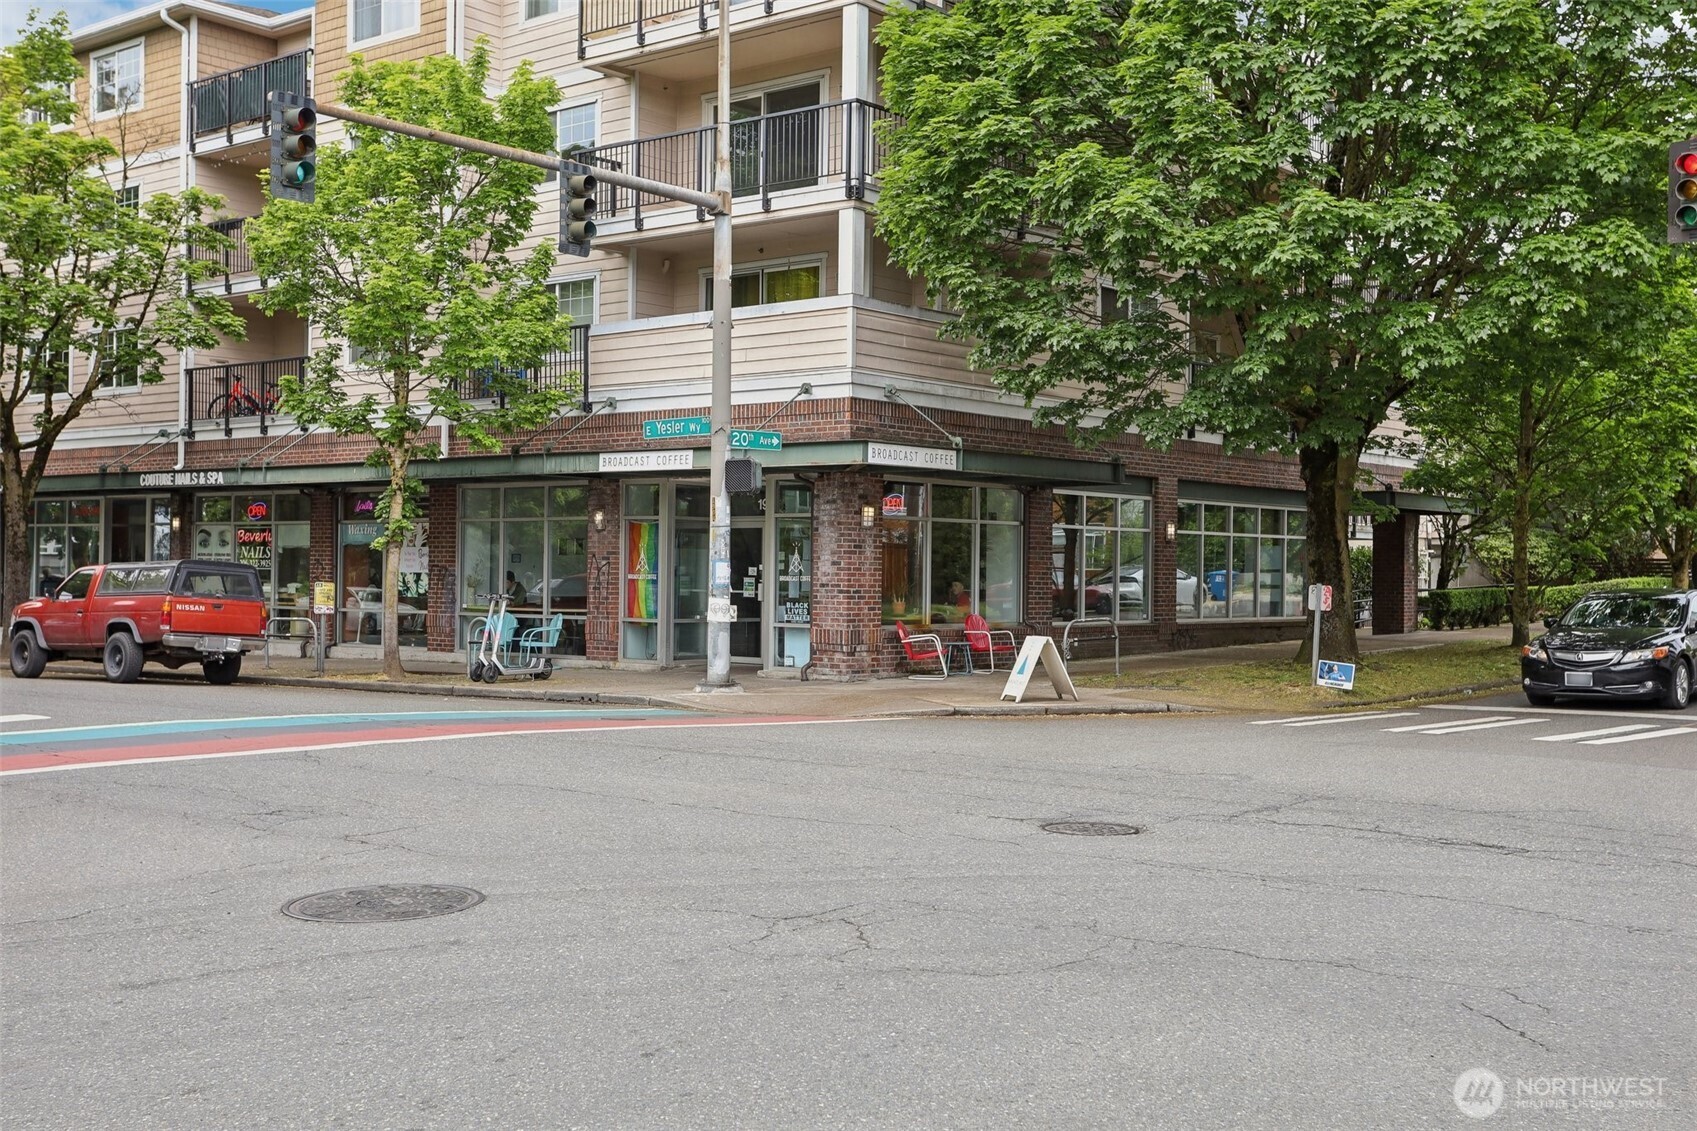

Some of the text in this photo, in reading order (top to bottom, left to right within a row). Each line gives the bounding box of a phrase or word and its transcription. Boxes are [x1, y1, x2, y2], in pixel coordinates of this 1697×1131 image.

[646, 421, 701, 436] E Yesler Wy
[731, 431, 772, 446] 20th Ave
[602, 454, 689, 467] BROADCAST COFFEE
[871, 447, 954, 466] BROADCAST COFFEE
[140, 471, 224, 486] COUTURE NAILS & SPA
[247, 505, 266, 516] OPEN
[348, 524, 378, 536] Waxing
[240, 546, 271, 559] NAILS
[176, 603, 205, 612] NISSAN
[786, 601, 809, 609] BLACK
